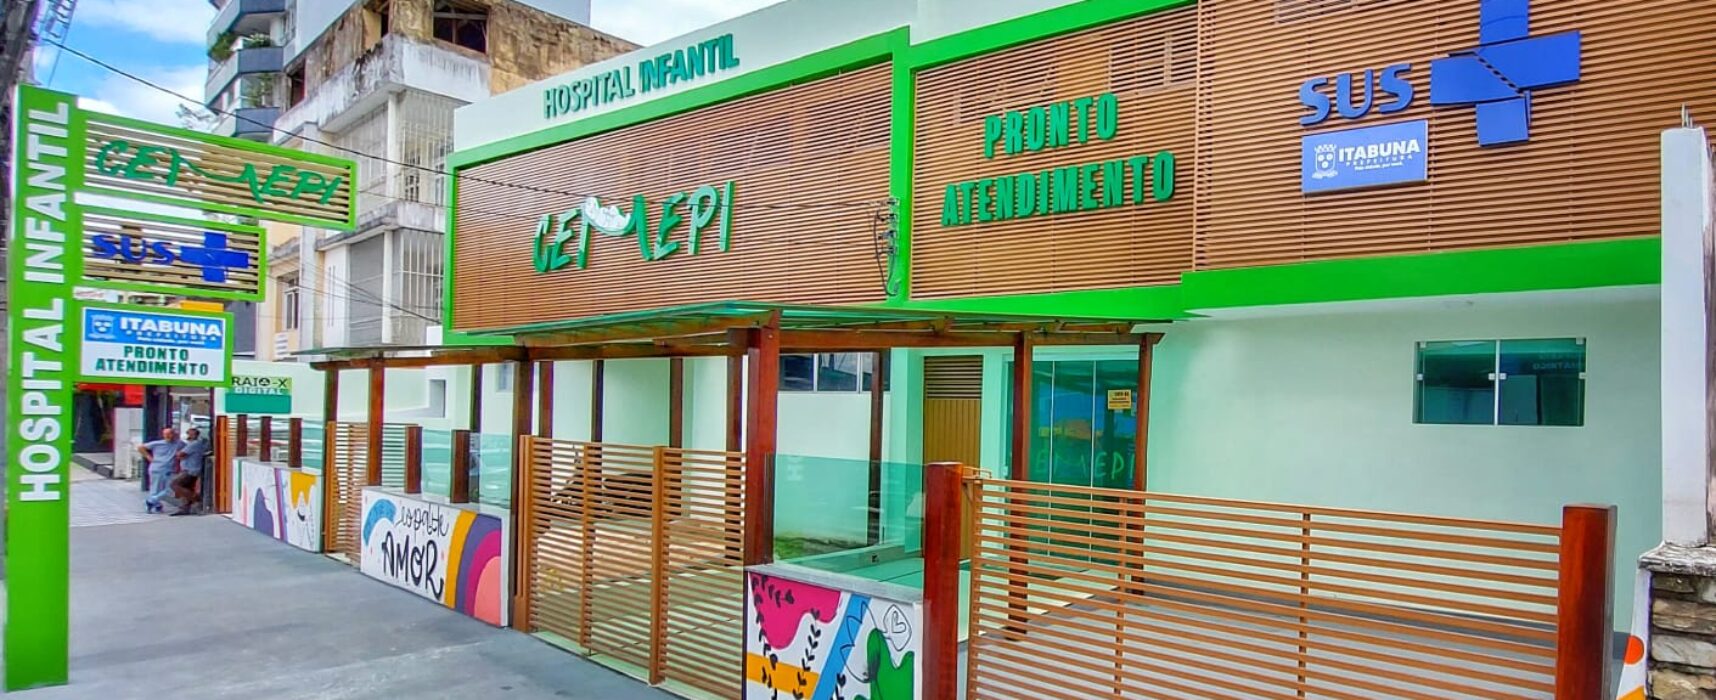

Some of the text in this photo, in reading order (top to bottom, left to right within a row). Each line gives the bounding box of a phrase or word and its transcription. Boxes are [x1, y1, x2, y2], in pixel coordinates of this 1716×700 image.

[543, 33, 740, 120] HOSPITAL INFANTIL
[1298, 62, 1413, 127] SUS
[983, 92, 1118, 159] PRONTO
[1339, 139, 1421, 162] ITABUNA
[96, 140, 343, 205] CEMEPI
[940, 150, 1175, 227] ATENDIMENTO
[92, 232, 176, 265] SUS
[531, 180, 735, 273] CEMEPI
[19, 102, 69, 502] HOSPITAL INFANTIL
[119, 316, 221, 336] ITABUNA
[95, 358, 209, 375] ATENDIMENTO
[124, 345, 189, 361] PRONTO
[231, 376, 288, 387] RAIO-X
[234, 387, 284, 395] DIGITAL
[381, 530, 444, 601] AMOR
